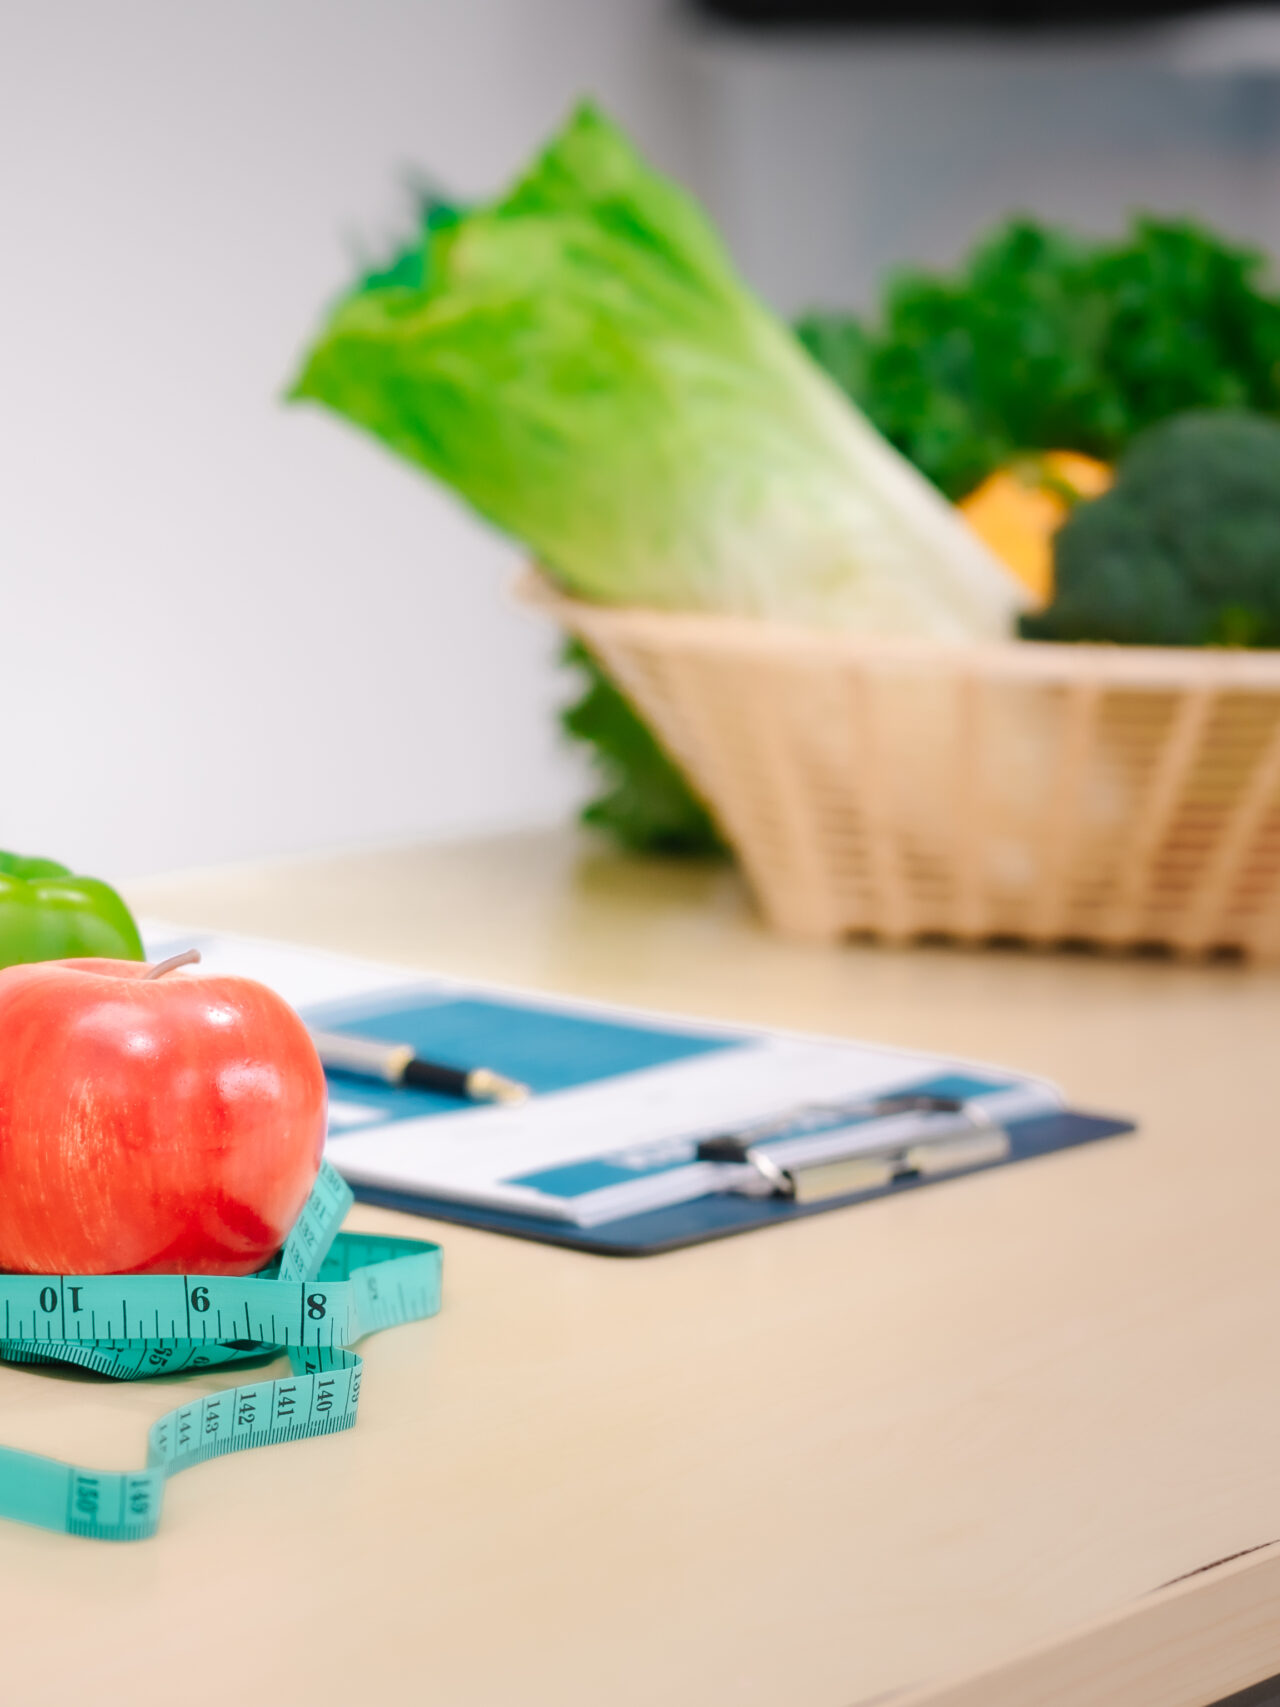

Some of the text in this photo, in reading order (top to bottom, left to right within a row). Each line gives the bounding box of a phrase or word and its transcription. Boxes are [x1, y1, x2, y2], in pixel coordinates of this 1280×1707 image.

[39, 1287, 84, 1313] 10
[190, 1286, 211, 1312] 9
[306, 1293, 327, 1320] 8
[238, 1391, 257, 1426] 142
[277, 1385, 297, 1418] 141
[316, 1379, 335, 1412] 140
[179, 1409, 192, 1445] 144
[205, 1400, 220, 1435] 143
